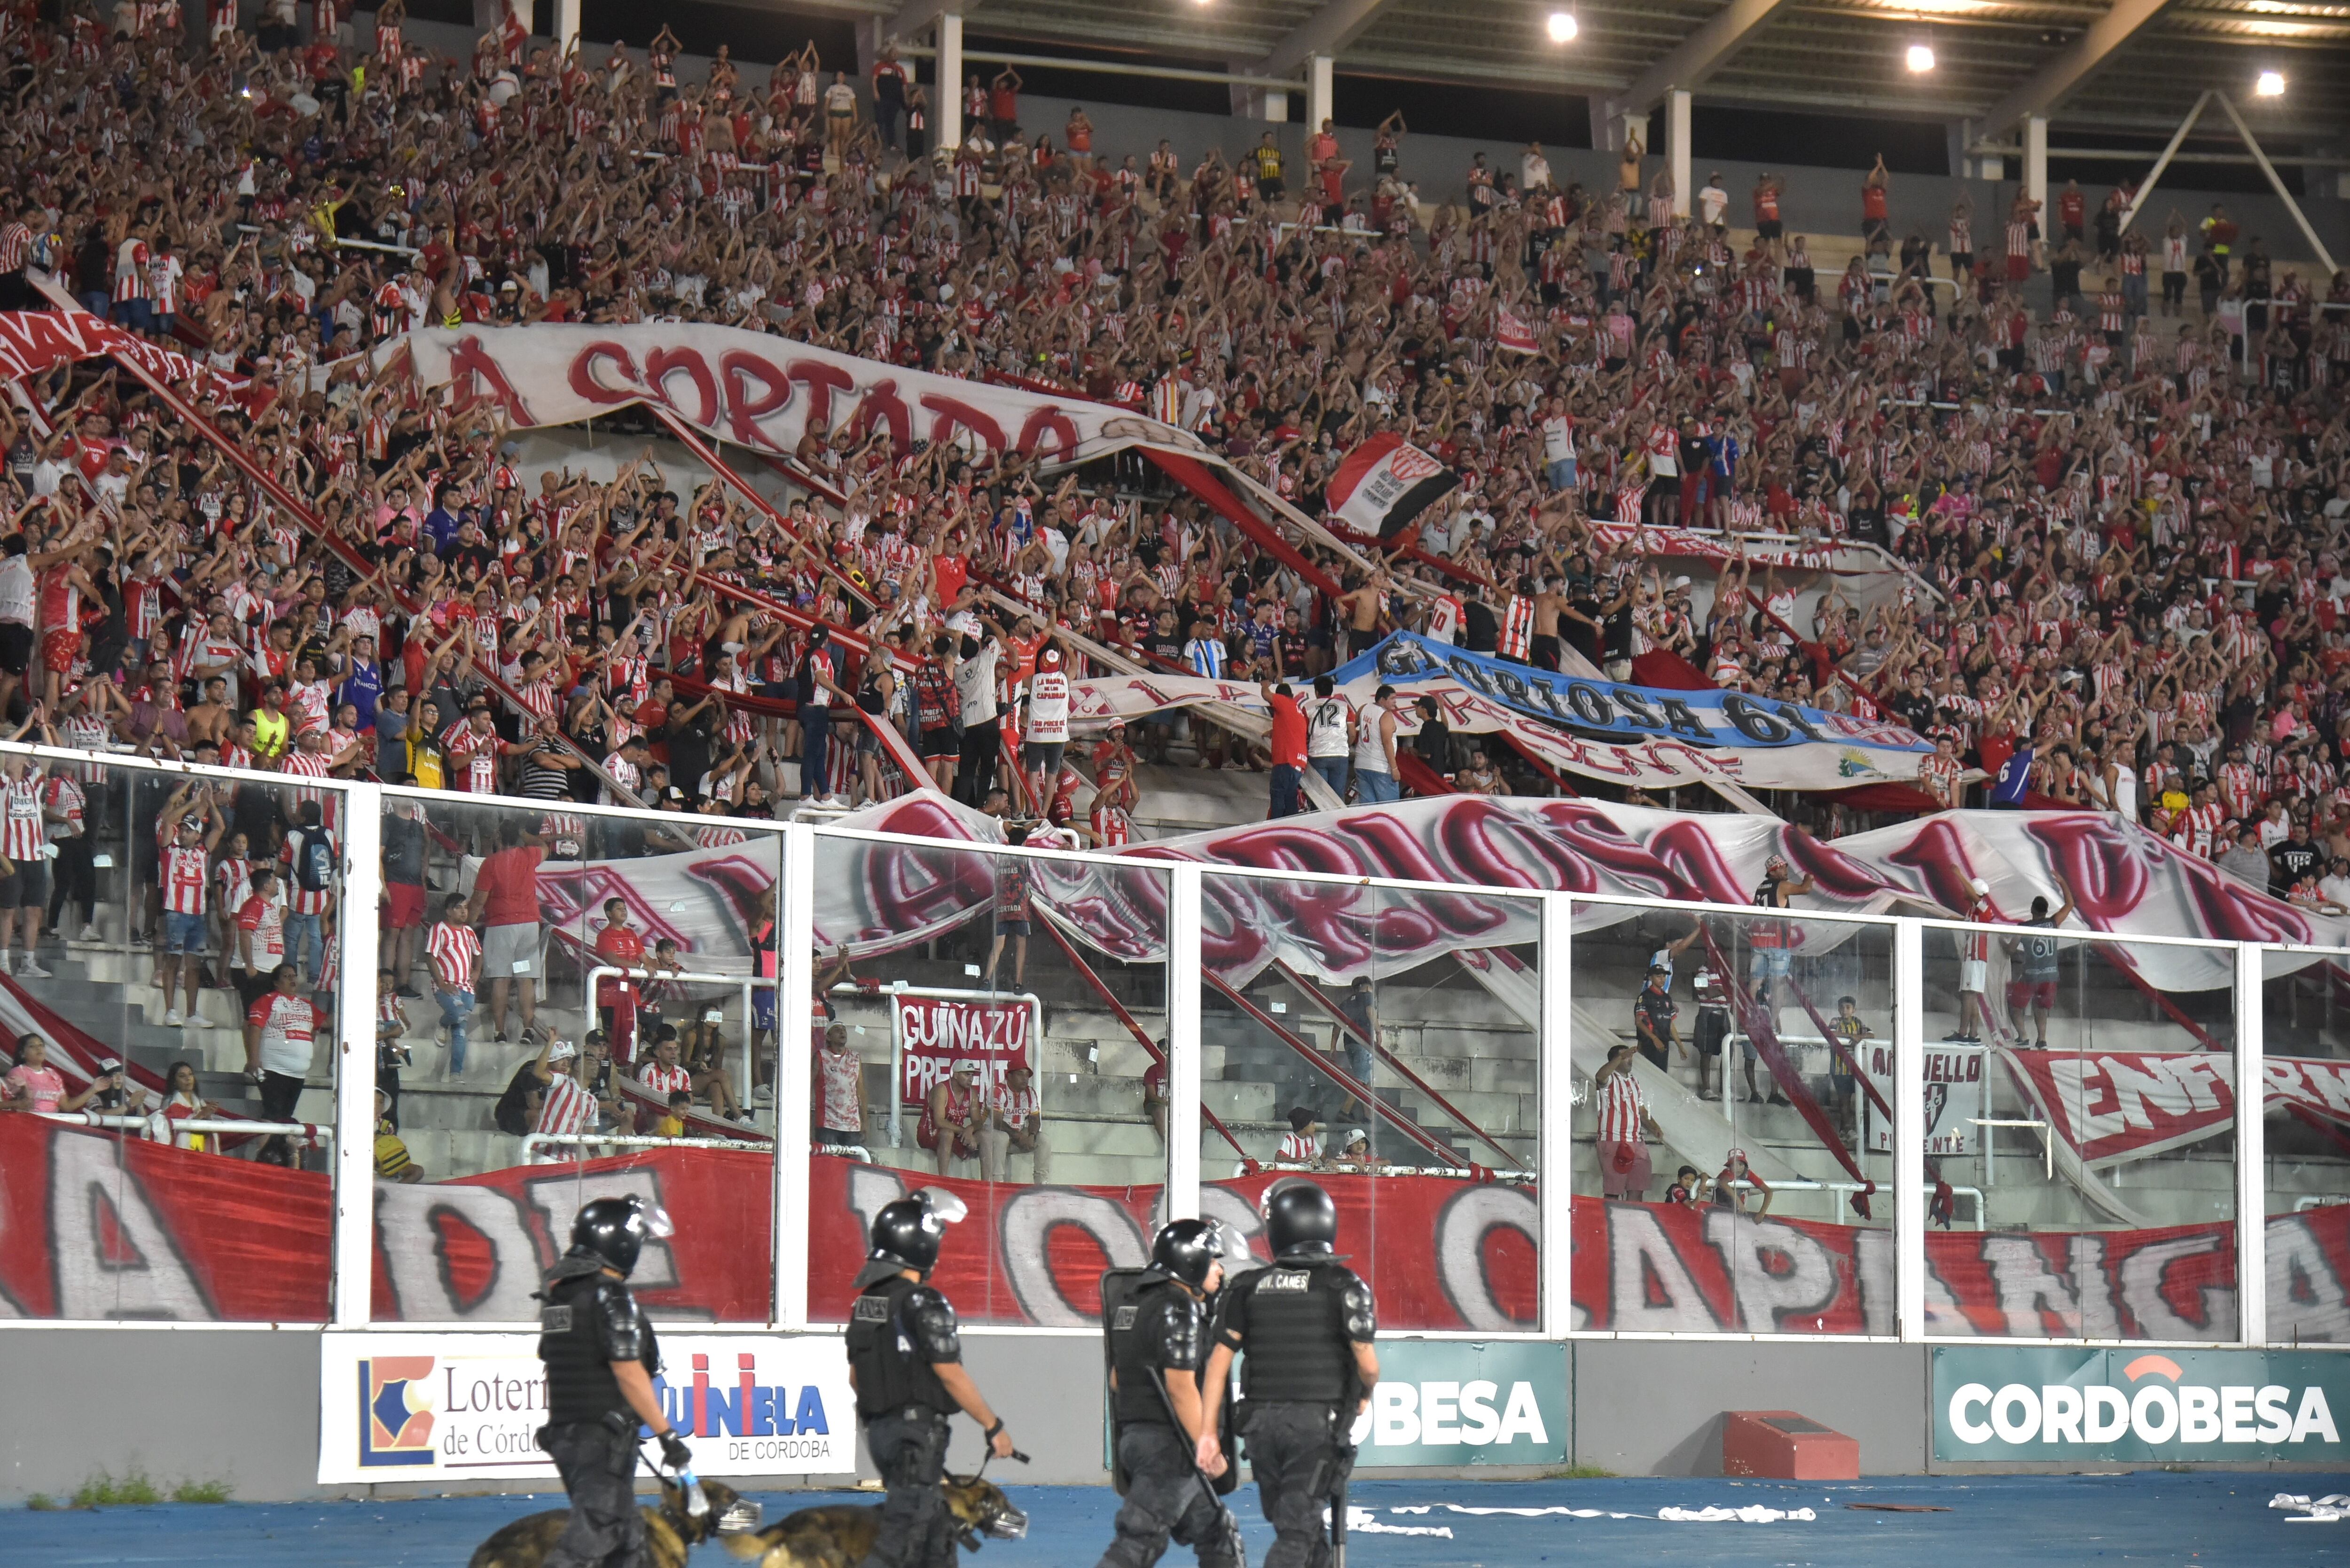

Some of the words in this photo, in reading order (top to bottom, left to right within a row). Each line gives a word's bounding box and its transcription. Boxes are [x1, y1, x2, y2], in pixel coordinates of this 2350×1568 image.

[1316, 703, 1340, 728] 12
[1999, 761, 2011, 783] 6
[1276, 1274, 1307, 1289] CANES
[444, 1366, 548, 1412] Loterí
[1949, 1383, 2341, 1444] CORDOBESA
[444, 1425, 469, 1456] de
[476, 1421, 543, 1456] Córdo
[729, 1442, 750, 1460] DE
[755, 1440, 830, 1460] CORDOBA
